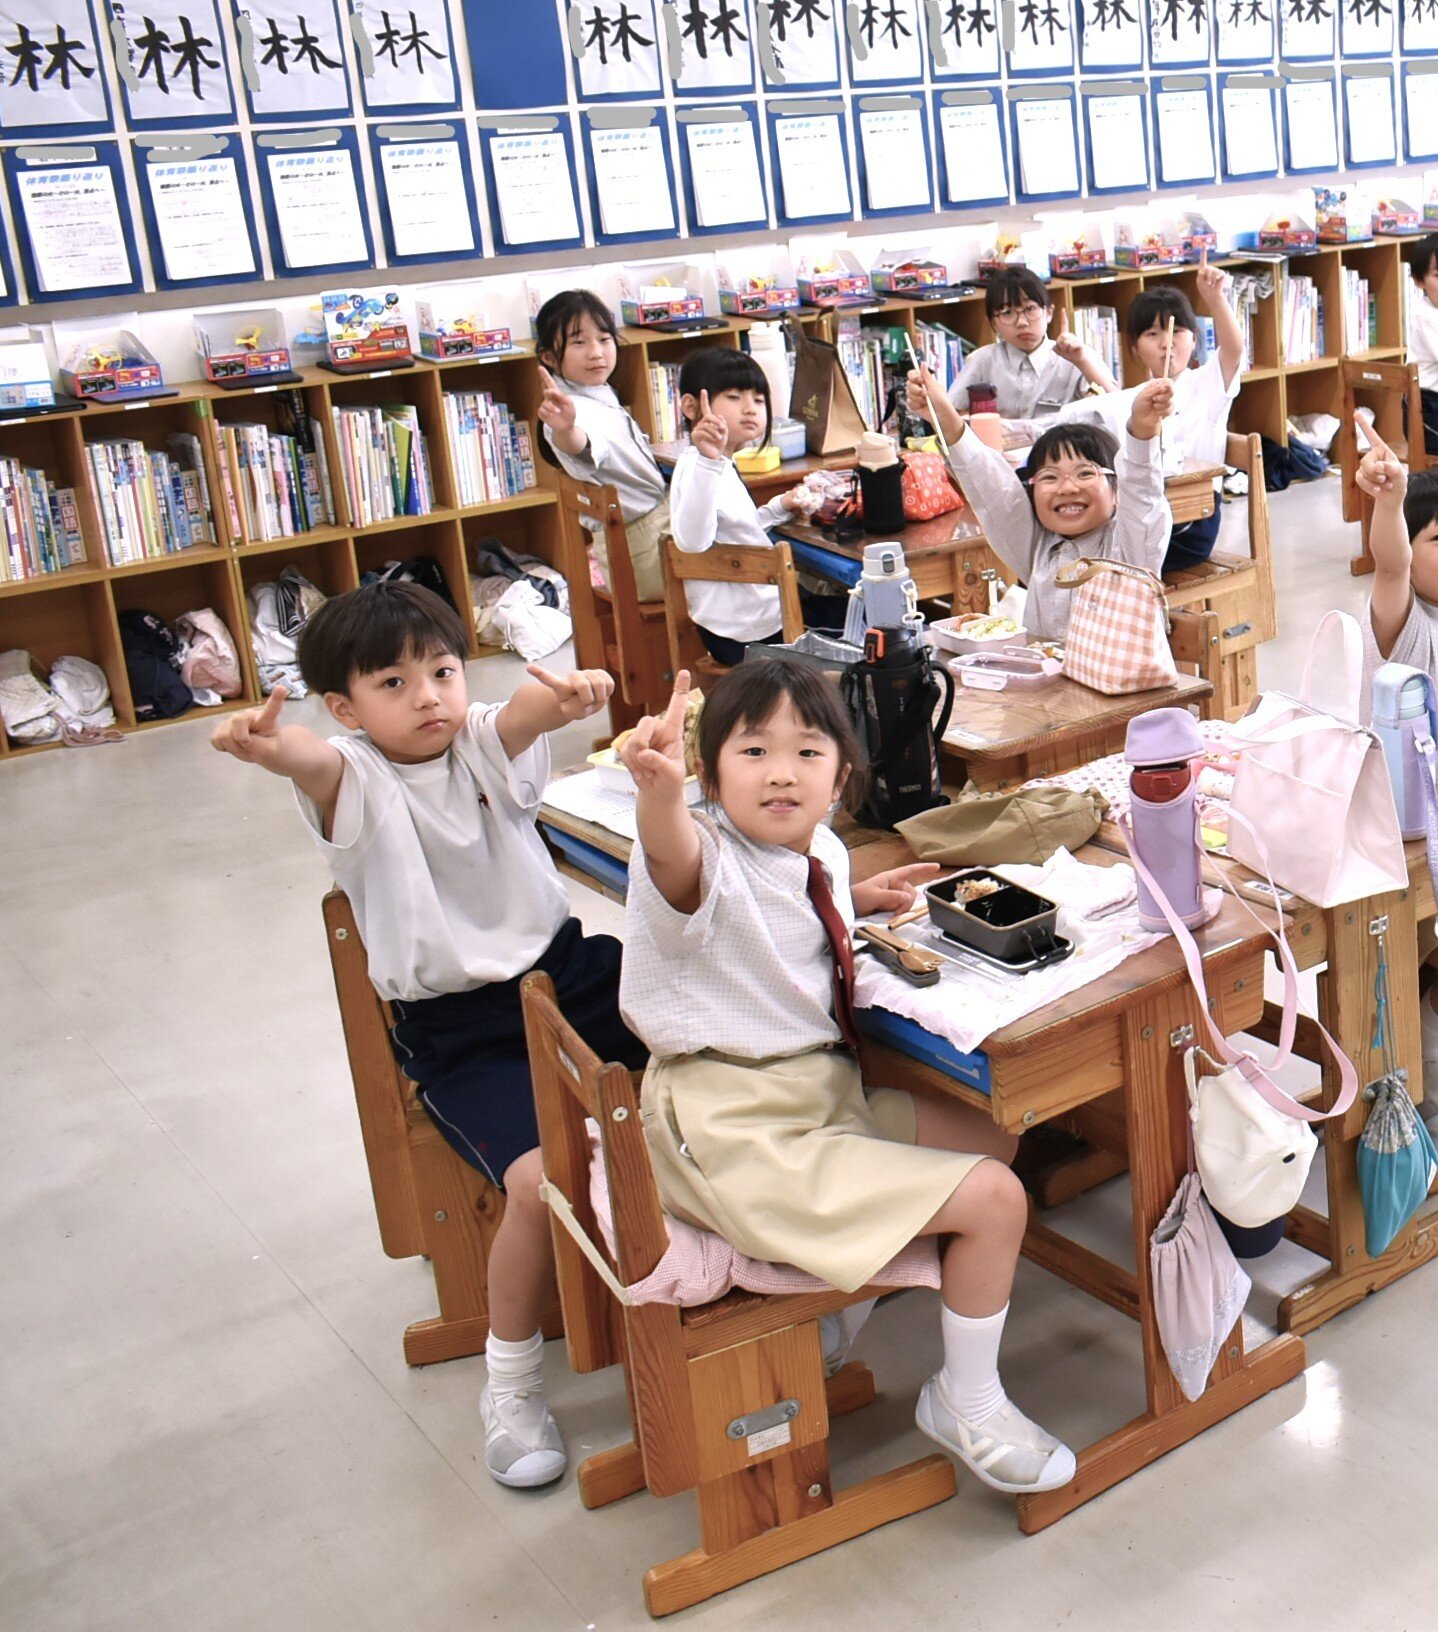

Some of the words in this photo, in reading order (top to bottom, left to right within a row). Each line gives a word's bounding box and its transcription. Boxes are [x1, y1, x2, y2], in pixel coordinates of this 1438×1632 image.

[585, 2, 655, 64] 林
[682, 0, 748, 59] 林
[768, 0, 830, 41] 林
[860, 0, 912, 49] 林
[943, 0, 996, 47] 林
[1019, 0, 1067, 46] 林
[1092, 0, 1138, 32] 林
[1228, 0, 1270, 28] 林
[1288, 0, 1332, 25] 林
[1348, 0, 1392, 28] 林
[5, 23, 95, 92] 林
[133, 15, 221, 101] 林
[260, 15, 343, 75] 林
[375, 10, 448, 75] 林
[26, 172, 105, 186] 体育祭振り返り
